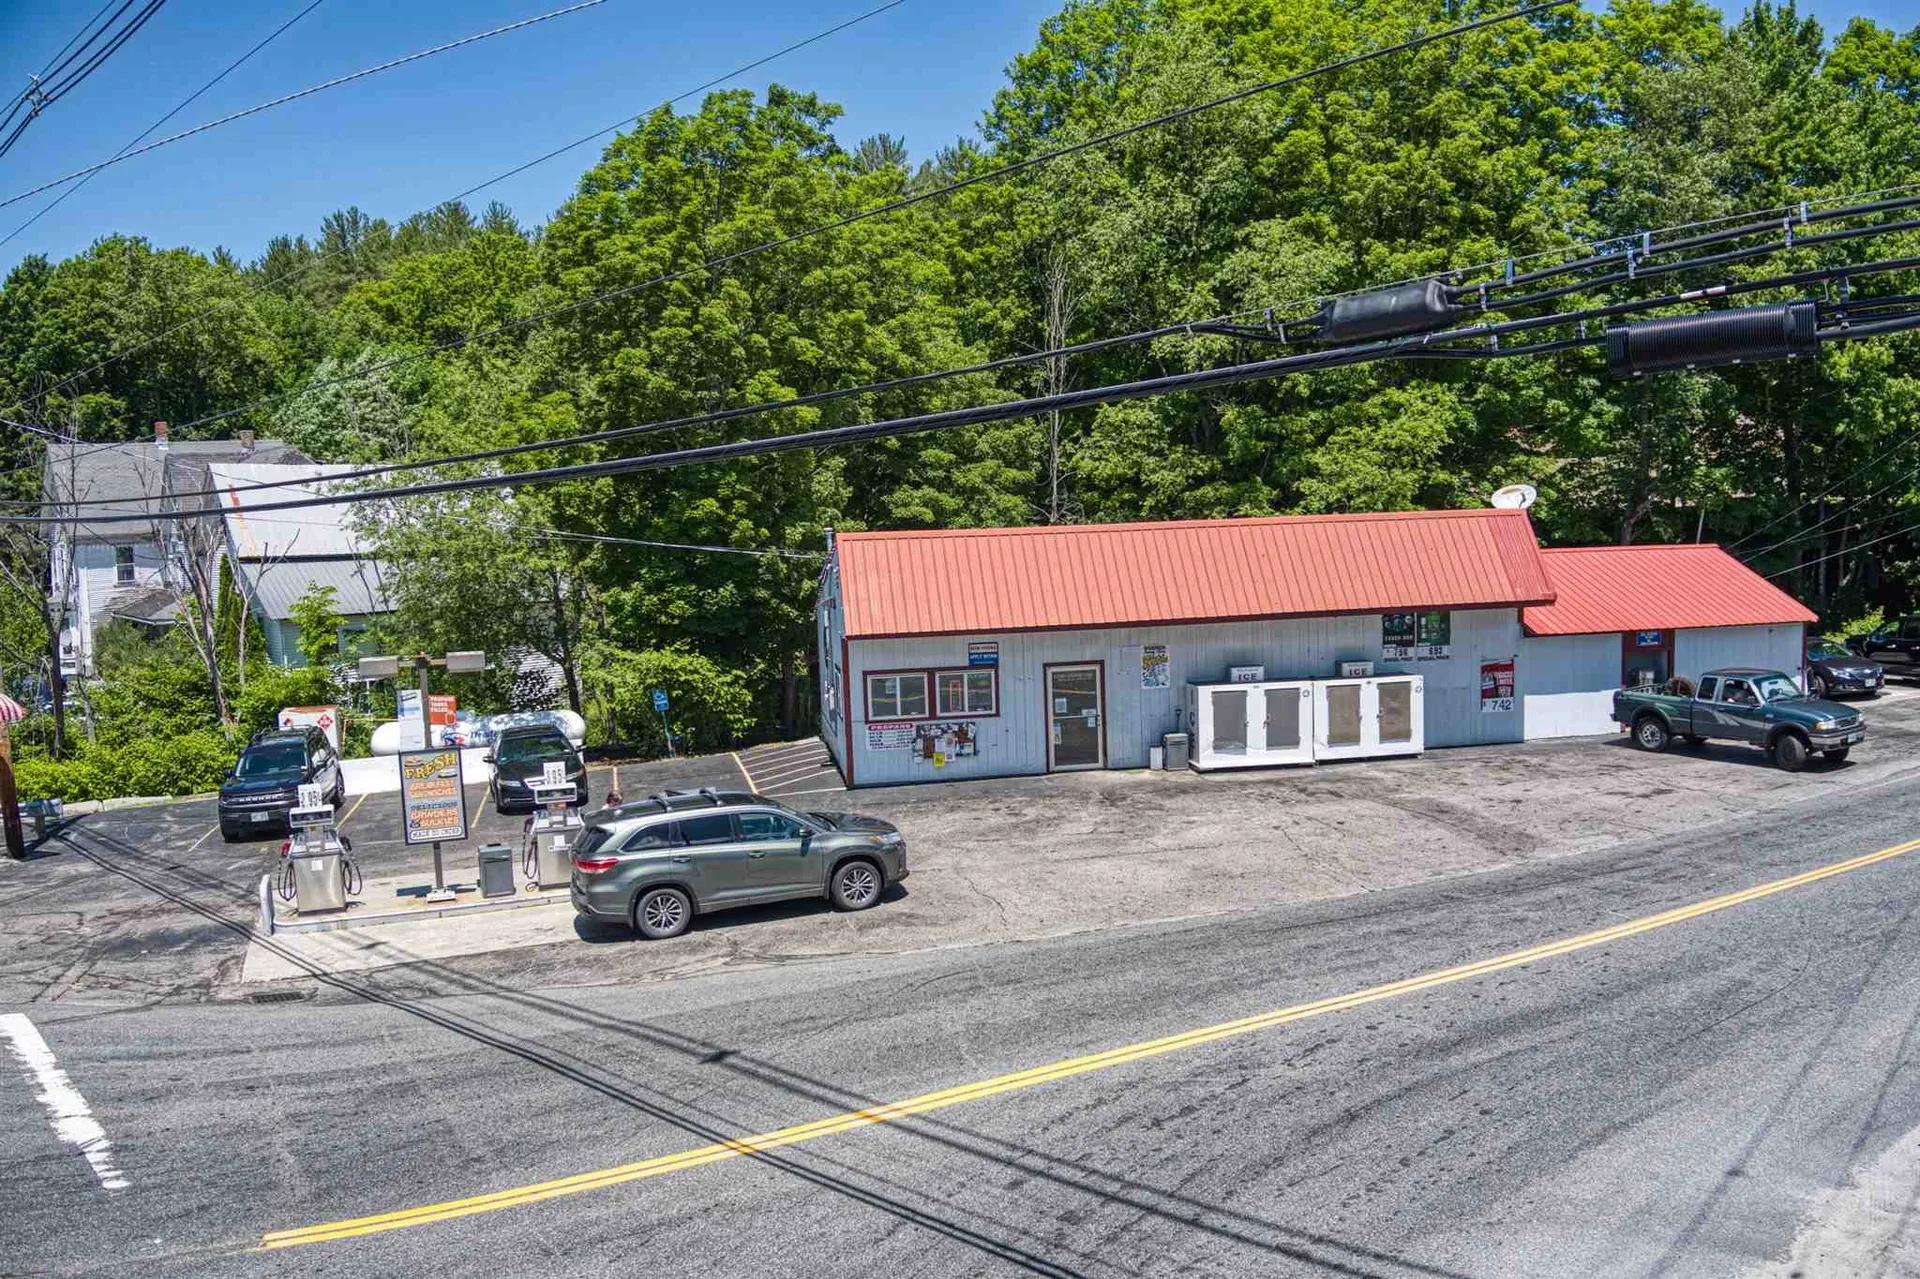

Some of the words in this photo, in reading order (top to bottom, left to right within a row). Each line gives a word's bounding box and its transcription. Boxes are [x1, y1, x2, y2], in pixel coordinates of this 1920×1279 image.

[1349, 668, 1367, 676] ICE
[1238, 673, 1257, 681] ICE
[1492, 699, 1511, 710] 742
[405, 753, 457, 779] FRESH
